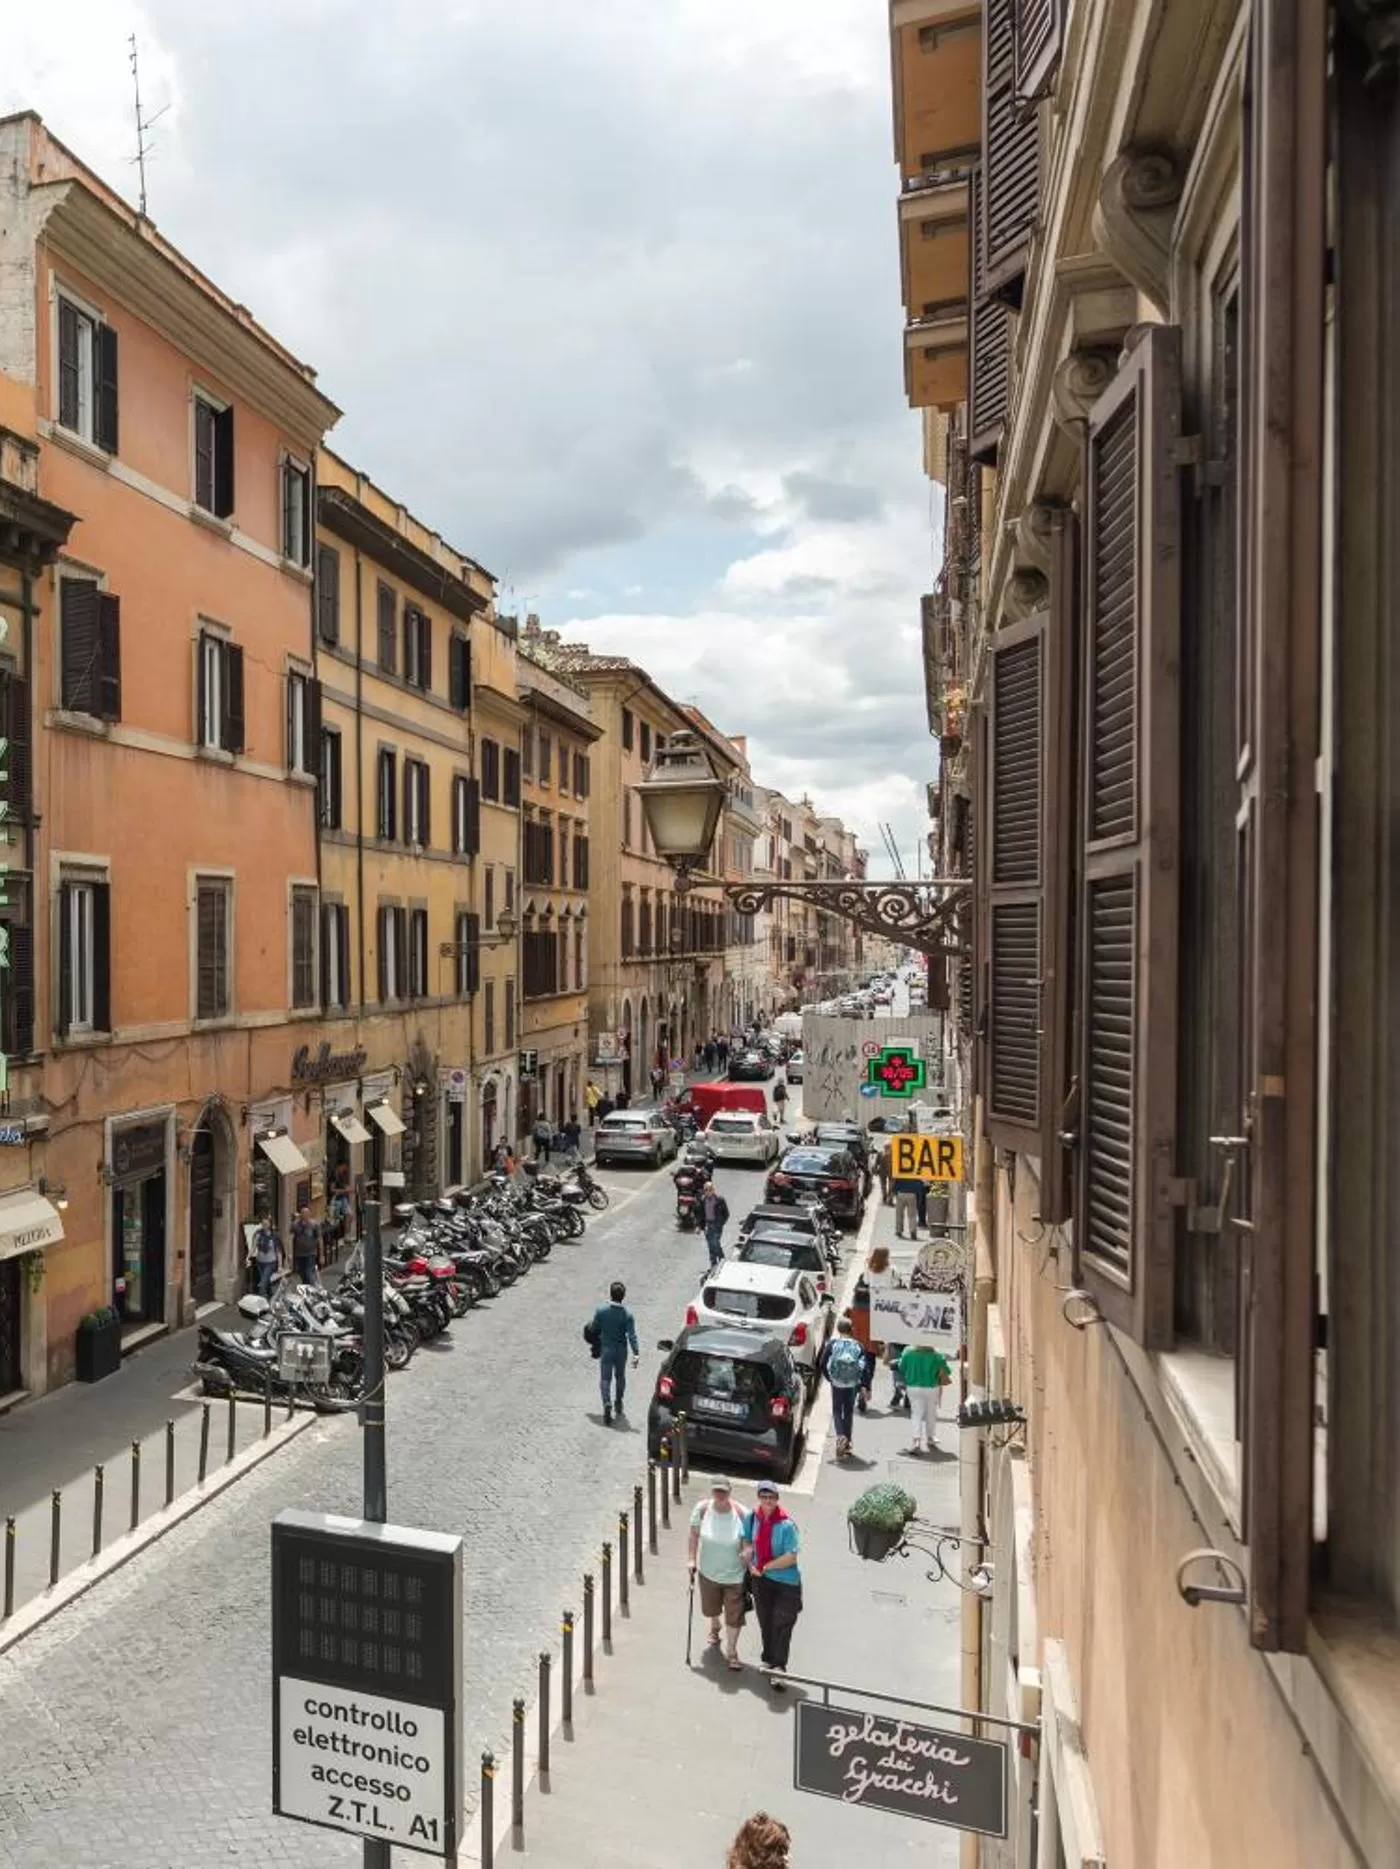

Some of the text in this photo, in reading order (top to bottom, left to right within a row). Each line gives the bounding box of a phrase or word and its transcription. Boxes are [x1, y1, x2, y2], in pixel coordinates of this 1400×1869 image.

[898, 1137, 957, 1178] BAR
[303, 1697, 419, 1738] controllo
[825, 1712, 971, 1766] gelateria
[292, 1725, 431, 1774] elettronico
[876, 1750, 915, 1772] dei
[310, 1764, 412, 1802] accesso
[843, 1756, 959, 1805] Gracchi
[328, 1794, 440, 1843] Z.T.L. A1
